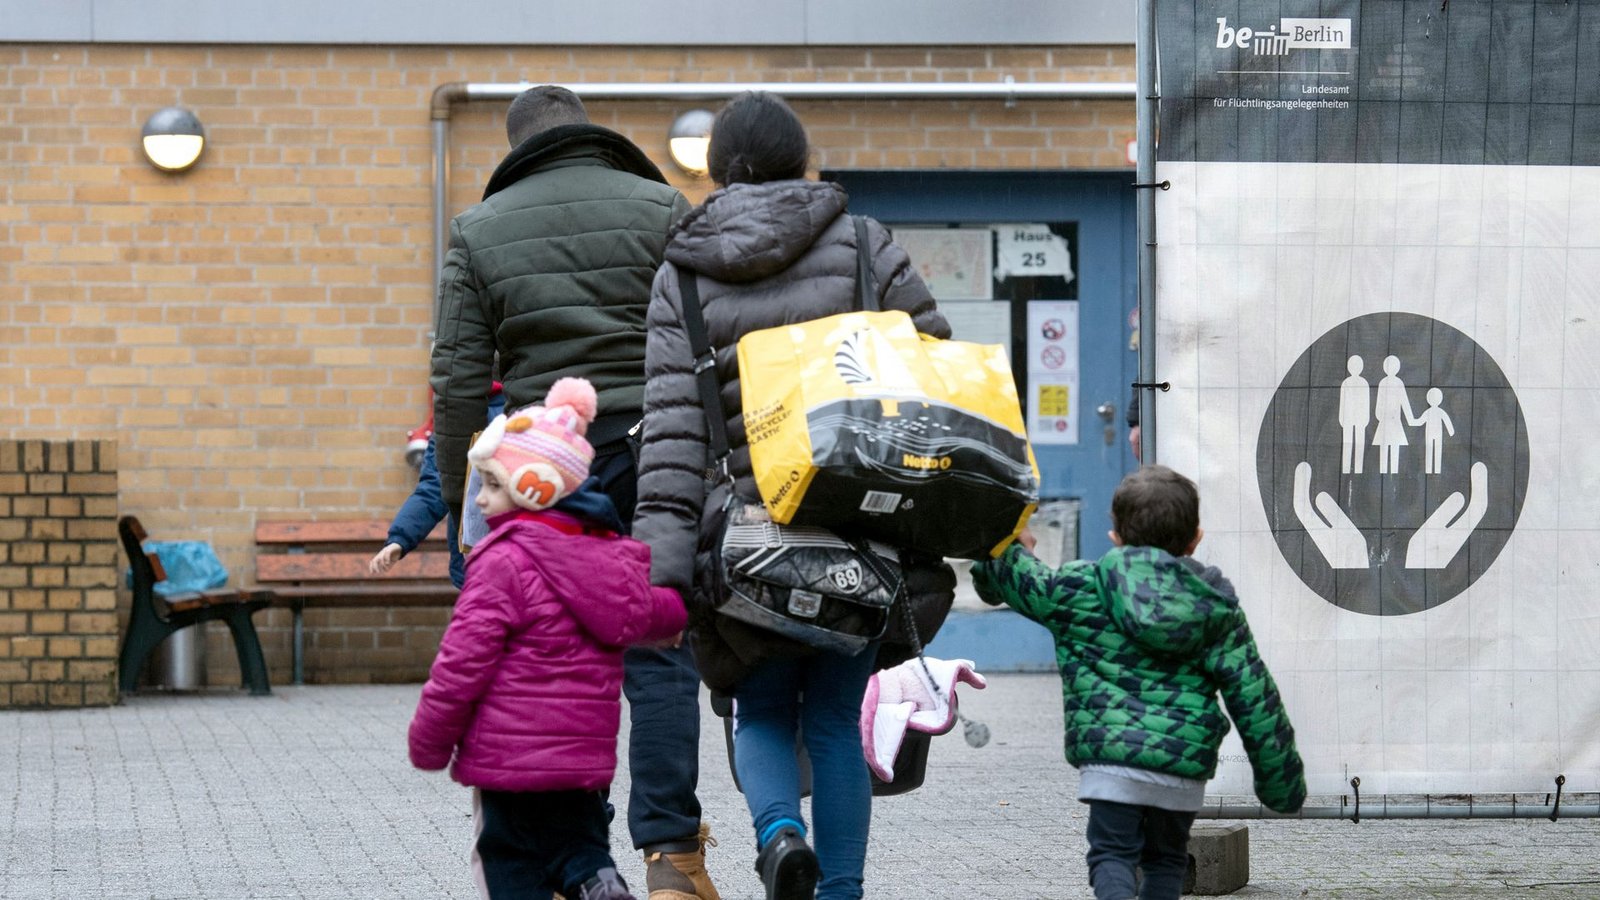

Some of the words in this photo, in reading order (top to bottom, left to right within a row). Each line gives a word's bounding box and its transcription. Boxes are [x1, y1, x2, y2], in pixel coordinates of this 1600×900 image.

[1216, 17, 1253, 48] be
[1293, 26, 1344, 42] Berlin
[1302, 85, 1350, 94] Landesamt
[1213, 98, 1227, 108] für
[1228, 98, 1349, 110] Flüchtlingsangelegenheiten
[1014, 230, 1053, 242] Haus
[1022, 252, 1046, 267] 25
[748, 425, 780, 445] LASTIC
[902, 453, 939, 469] Netto
[769, 481, 791, 509] Netto
[835, 568, 858, 588] 69
